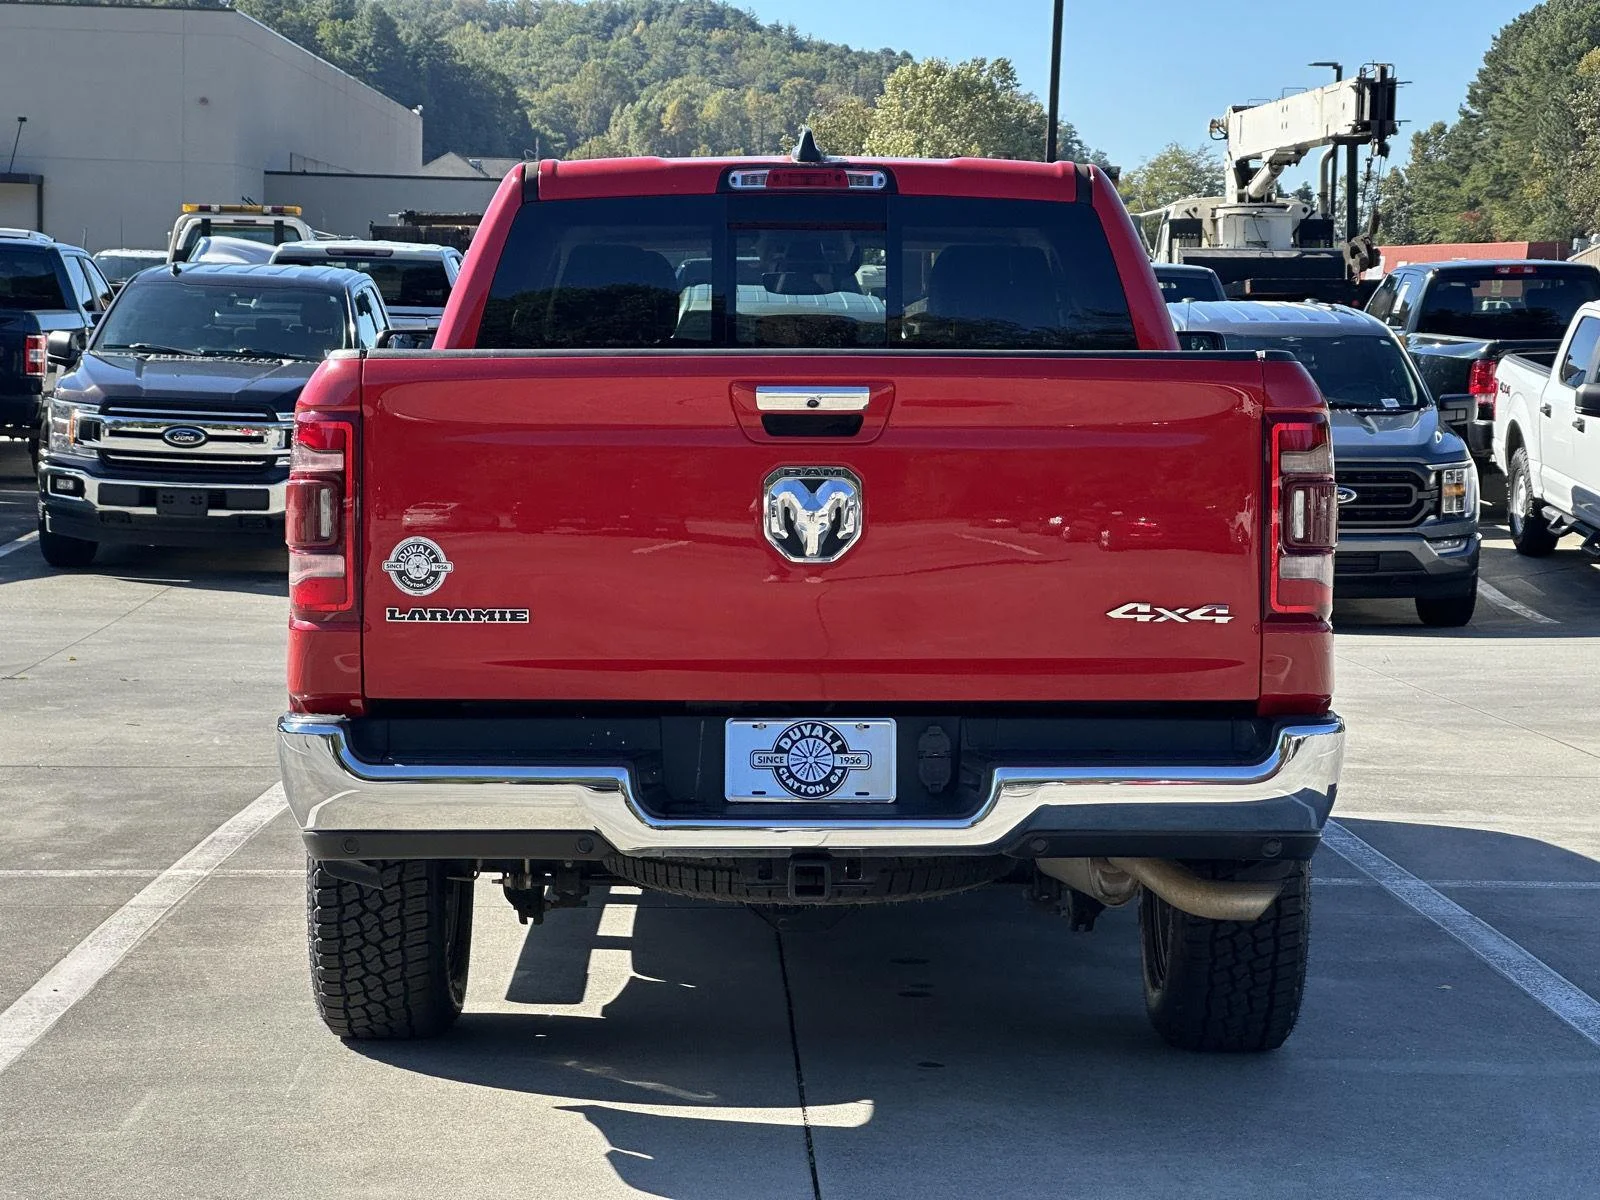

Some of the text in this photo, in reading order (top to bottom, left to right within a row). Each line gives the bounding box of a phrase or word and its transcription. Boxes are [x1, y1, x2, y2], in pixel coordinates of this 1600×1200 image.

[173, 430, 195, 441] Ford
[783, 468, 843, 476] RAM
[398, 544, 436, 562] DUVALL
[426, 576, 436, 585] GA
[386, 607, 529, 623] LARAMIE
[1106, 602, 1234, 624] 4x4
[779, 723, 843, 752] DUVALL
[757, 755, 784, 765] SINCE
[839, 756, 862, 765] 1956
[778, 767, 844, 795] CLAYTON, GA
